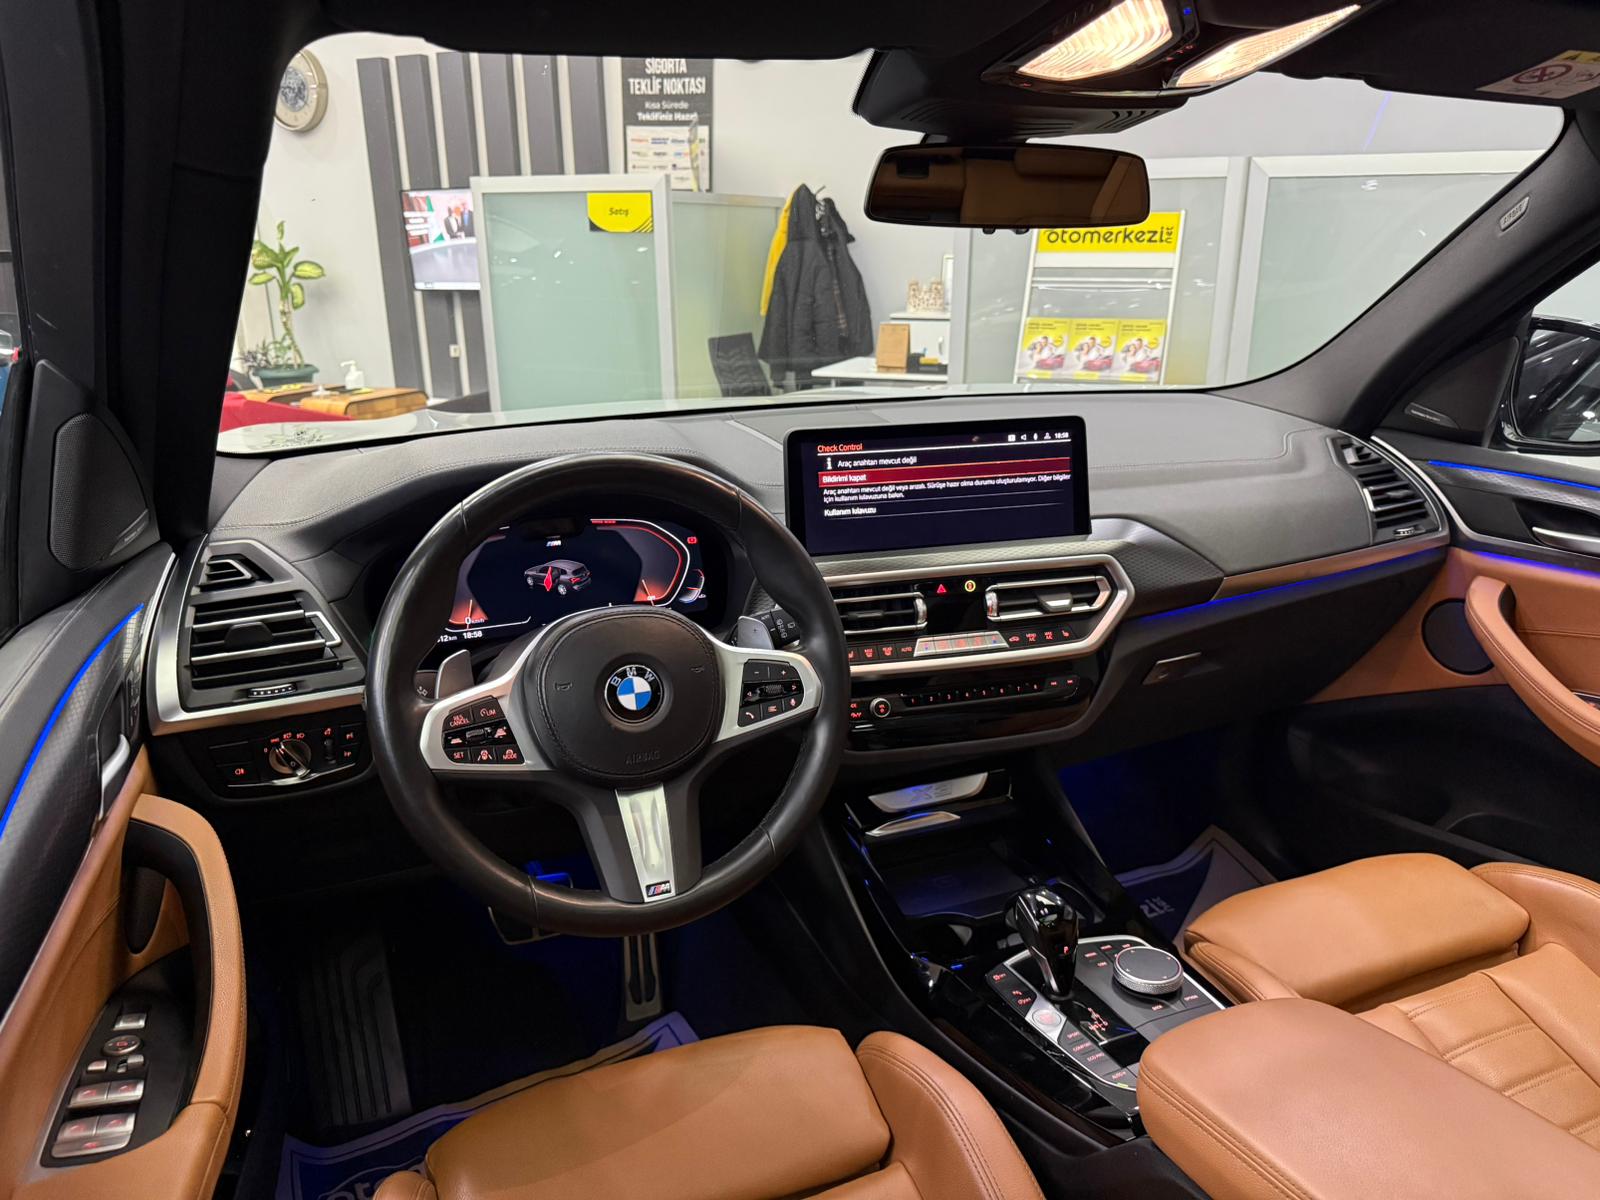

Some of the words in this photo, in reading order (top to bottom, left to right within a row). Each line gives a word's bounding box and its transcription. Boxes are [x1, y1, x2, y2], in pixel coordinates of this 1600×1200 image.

[645, 57, 687, 74] SİGORTA
[628, 75, 662, 95] TEKLİF
[663, 76, 706, 95] NOKTASI
[662, 100, 689, 110] Sürede
[637, 112, 673, 121] Teklifiniz
[1047, 226, 1164, 244] otomerkezi
[817, 445, 837, 453] Check
[838, 443, 863, 452] Control
[837, 460, 852, 468] Araç
[879, 457, 901, 465] mevcut
[901, 456, 917, 464] değil
[822, 475, 849, 483] Bildirimi
[849, 474, 867, 483] kapat
[824, 508, 851, 516] Kullanım
[465, 617, 471, 625] 0
[611, 667, 655, 687] BMW
